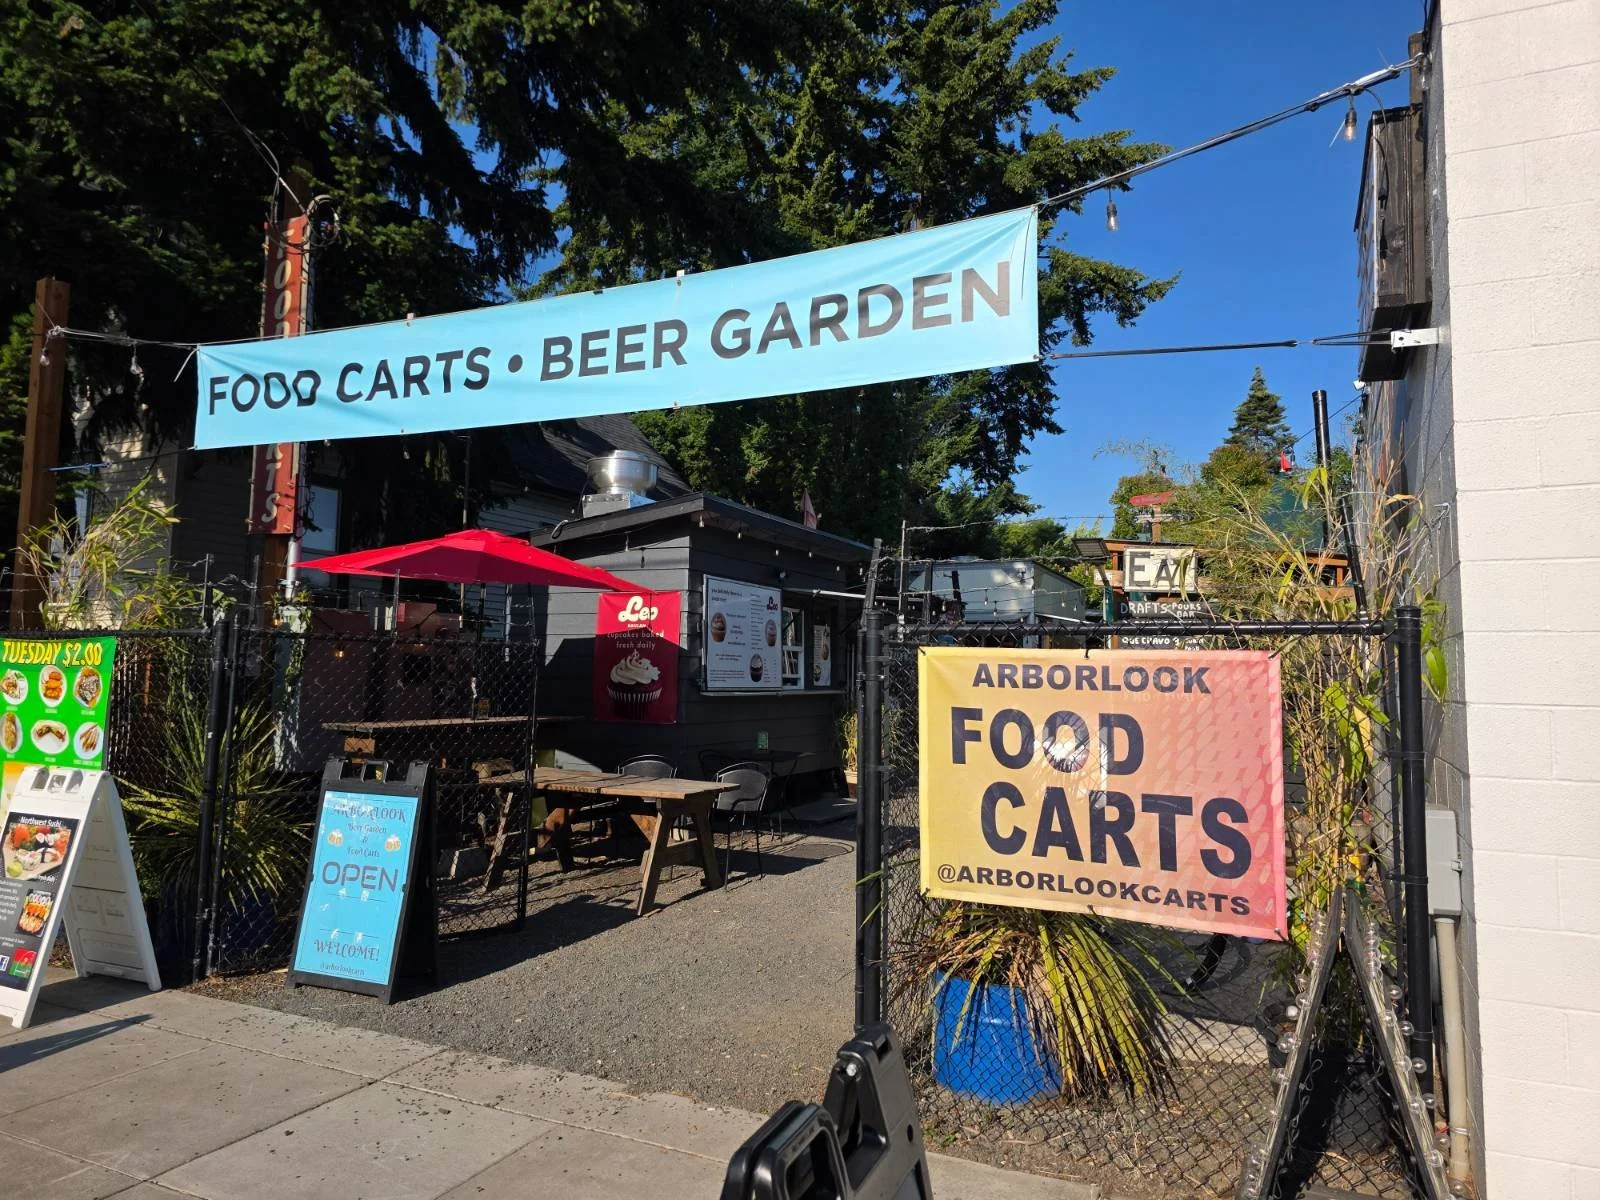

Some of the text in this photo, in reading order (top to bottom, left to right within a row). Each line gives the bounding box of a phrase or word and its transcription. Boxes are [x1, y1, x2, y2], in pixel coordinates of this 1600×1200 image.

[208, 261, 1010, 415] FOOD CARTS BEER GARDEN
[1129, 551, 1186, 588] EA
[617, 594, 659, 622] Leo
[1120, 600, 1168, 615] DRAFTS
[1176, 610, 1195, 618] BAR
[607, 629, 664, 640] cupcakes baked
[616, 641, 656, 650] fresh daily
[2, 641, 102, 668] TUESDAY $2.00
[972, 663, 1211, 694] ARBORLOOK
[951, 706, 1145, 776] FOOD
[20, 816, 62, 827] Northwest Sushi
[364, 824, 387, 834] Garden
[980, 781, 1252, 879] CARTS
[322, 861, 398, 892] OPEN
[937, 863, 1250, 916] @ARBORLOOKCARTS
[314, 939, 380, 961] WELCOME!
